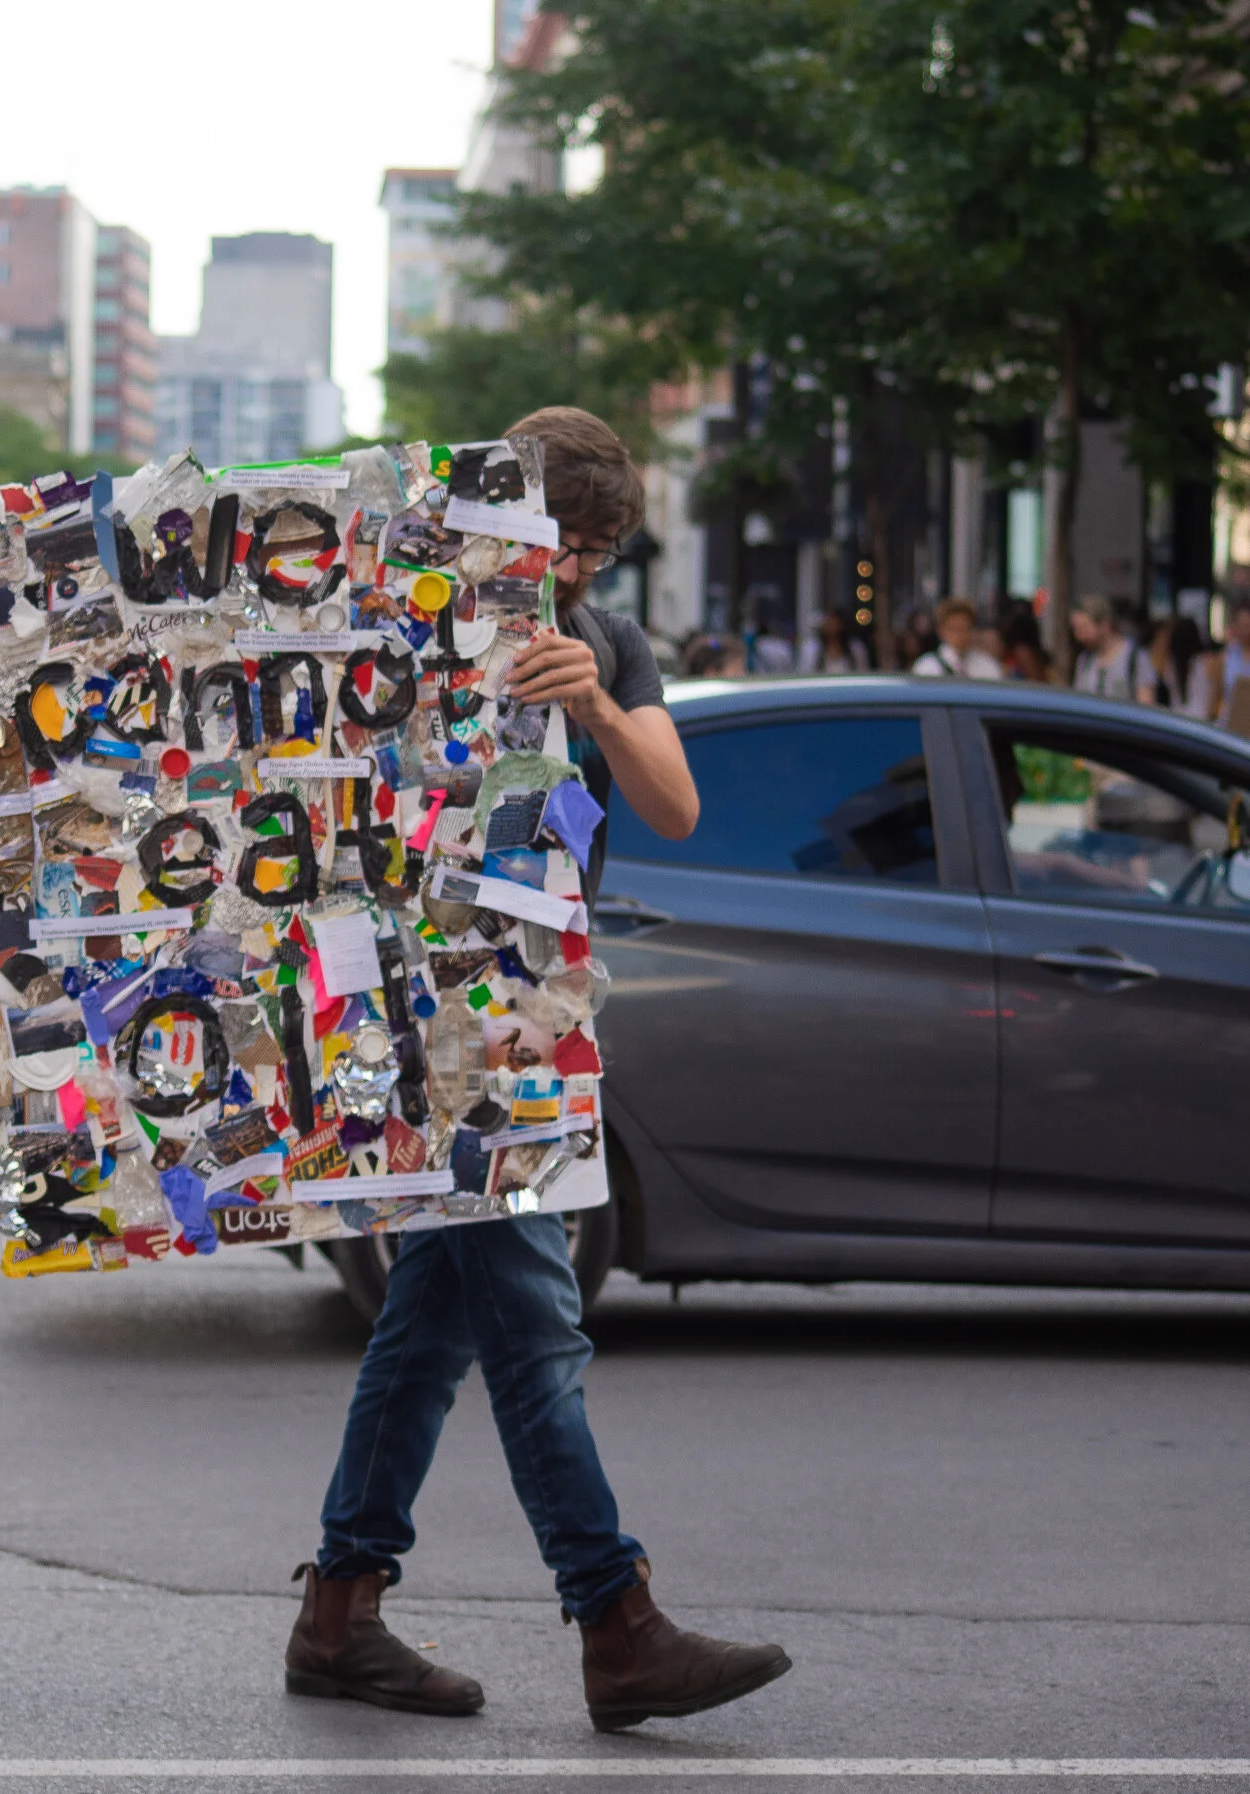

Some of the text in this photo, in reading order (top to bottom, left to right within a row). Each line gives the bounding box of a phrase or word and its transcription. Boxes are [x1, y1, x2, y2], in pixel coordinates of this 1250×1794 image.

[16, 594, 486, 769] cannot
[136, 757, 396, 908] eat
[303, 769, 325, 777] Pipeline
[58, 888, 71, 918] esk
[115, 954, 430, 1136] oil
